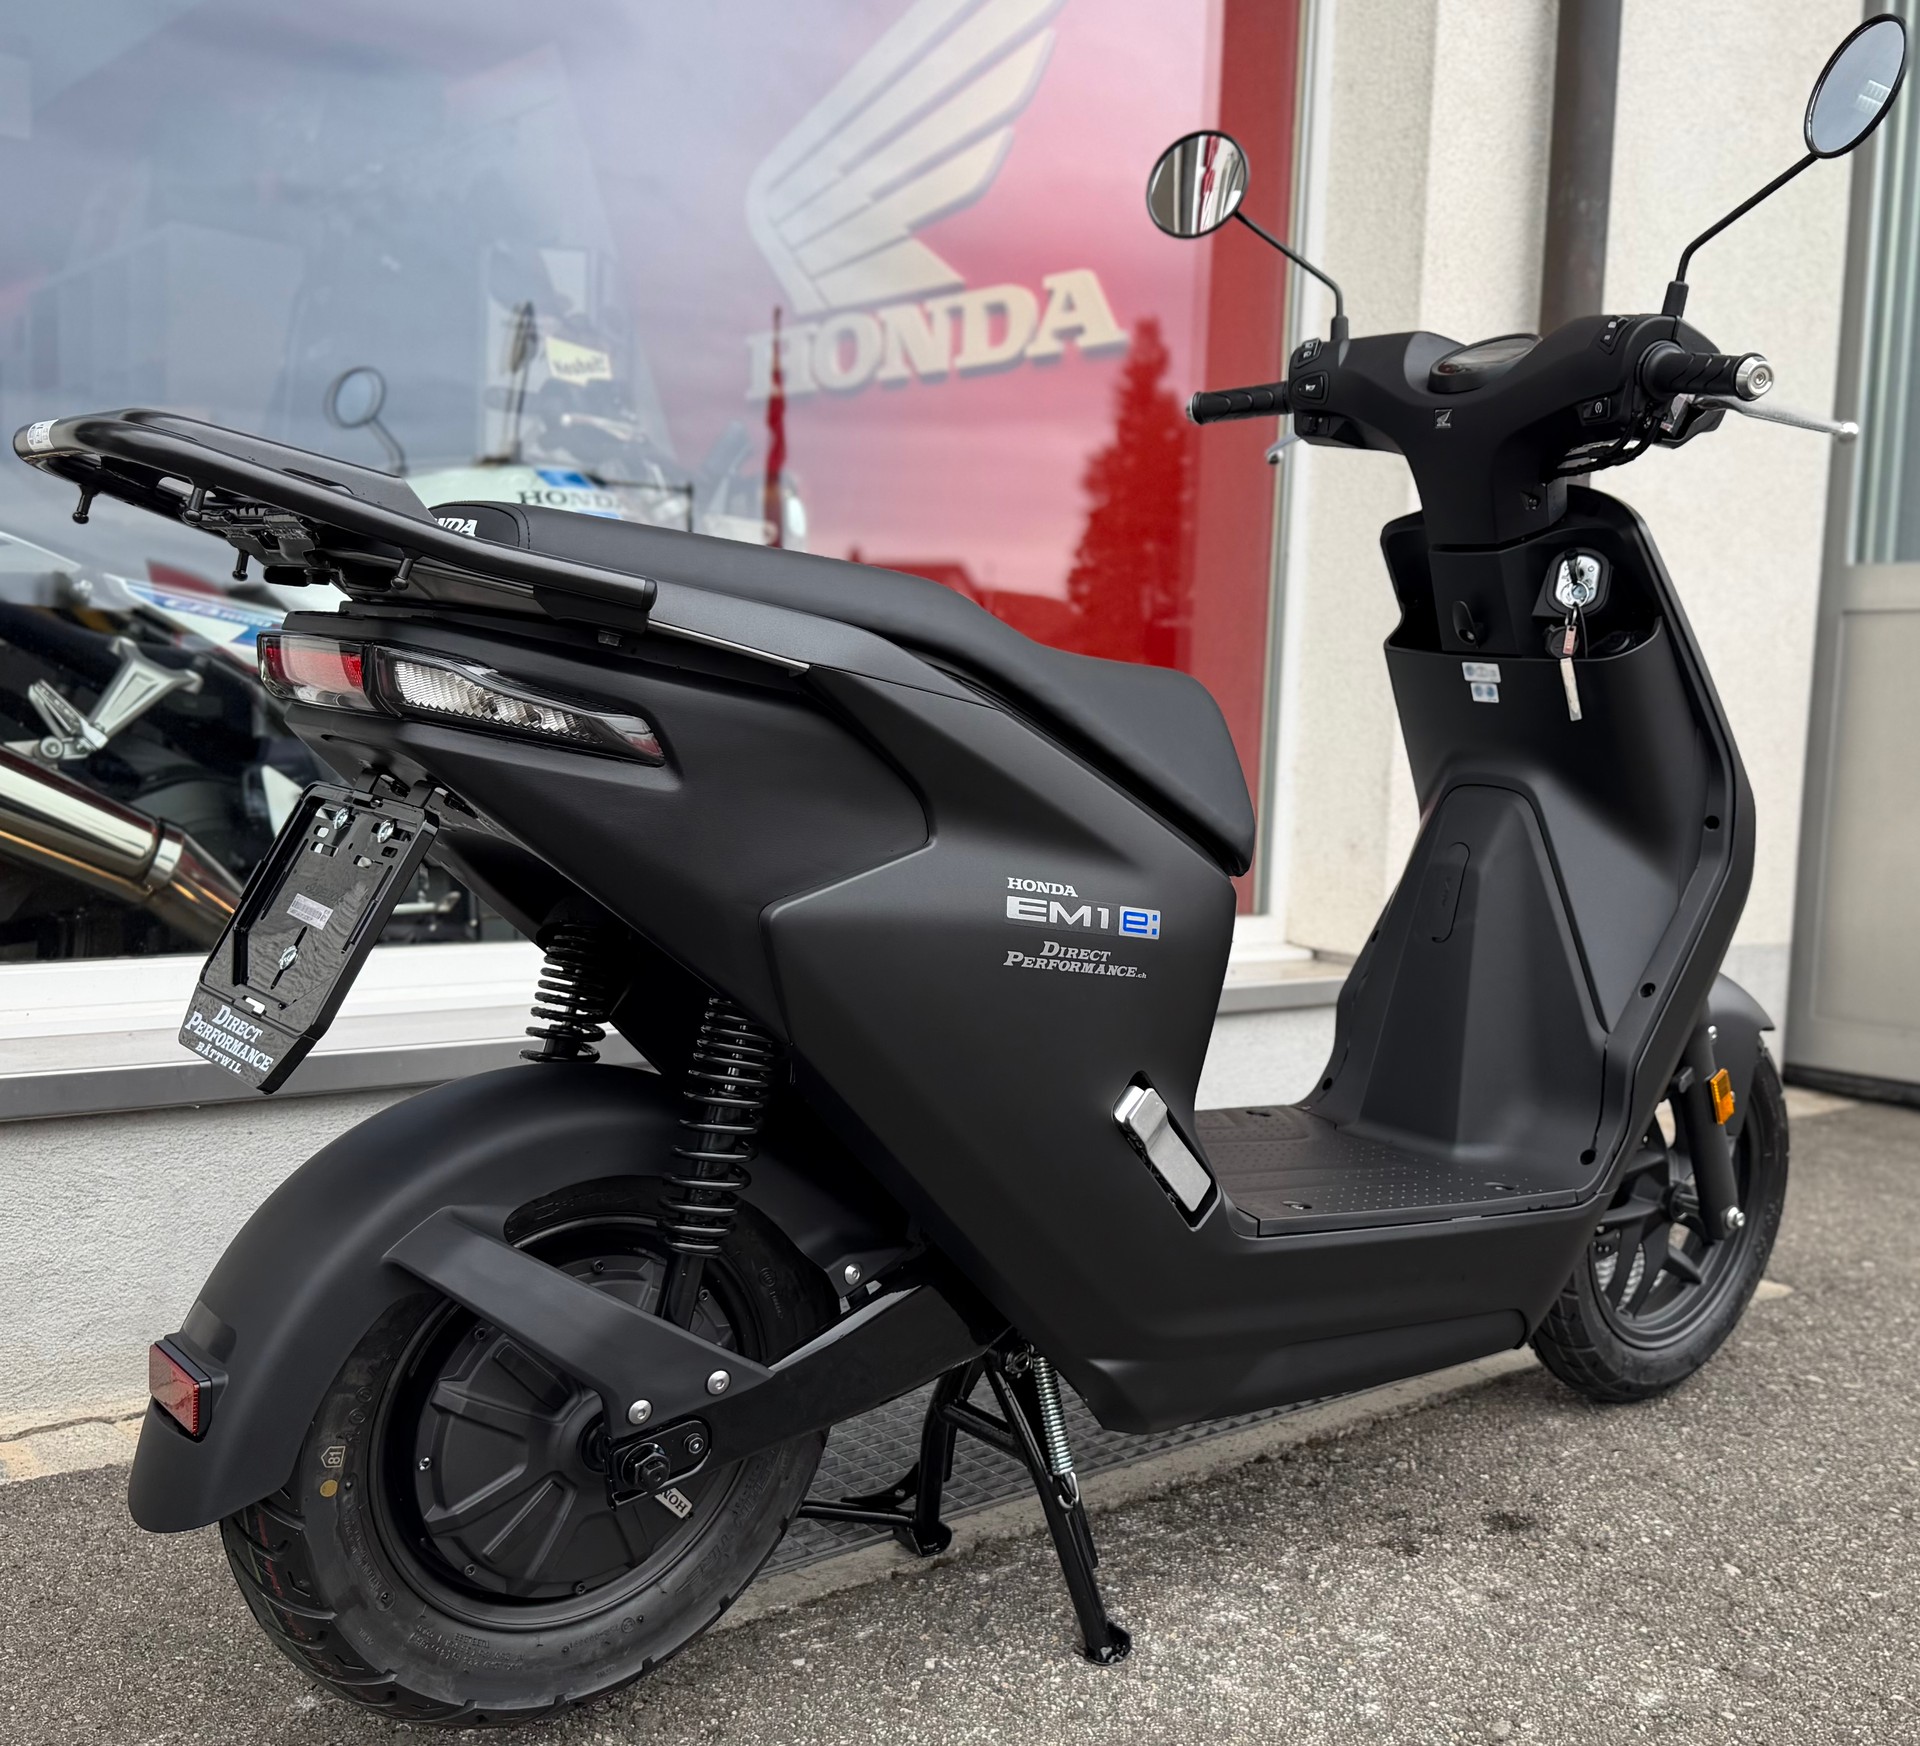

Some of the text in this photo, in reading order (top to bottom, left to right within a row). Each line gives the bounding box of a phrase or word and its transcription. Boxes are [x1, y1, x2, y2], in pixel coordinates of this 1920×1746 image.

[744, 268, 1128, 400] HONDA
[434, 517, 478, 537] NDA
[1007, 876, 1079, 898] HONDA
[1006, 895, 1110, 930] EM1
[1040, 940, 1112, 962] DIRECT
[212, 1004, 264, 1043] DIRECT
[184, 1011, 275, 1072] PERFORMANCE
[327, 1450, 342, 1466] 81
